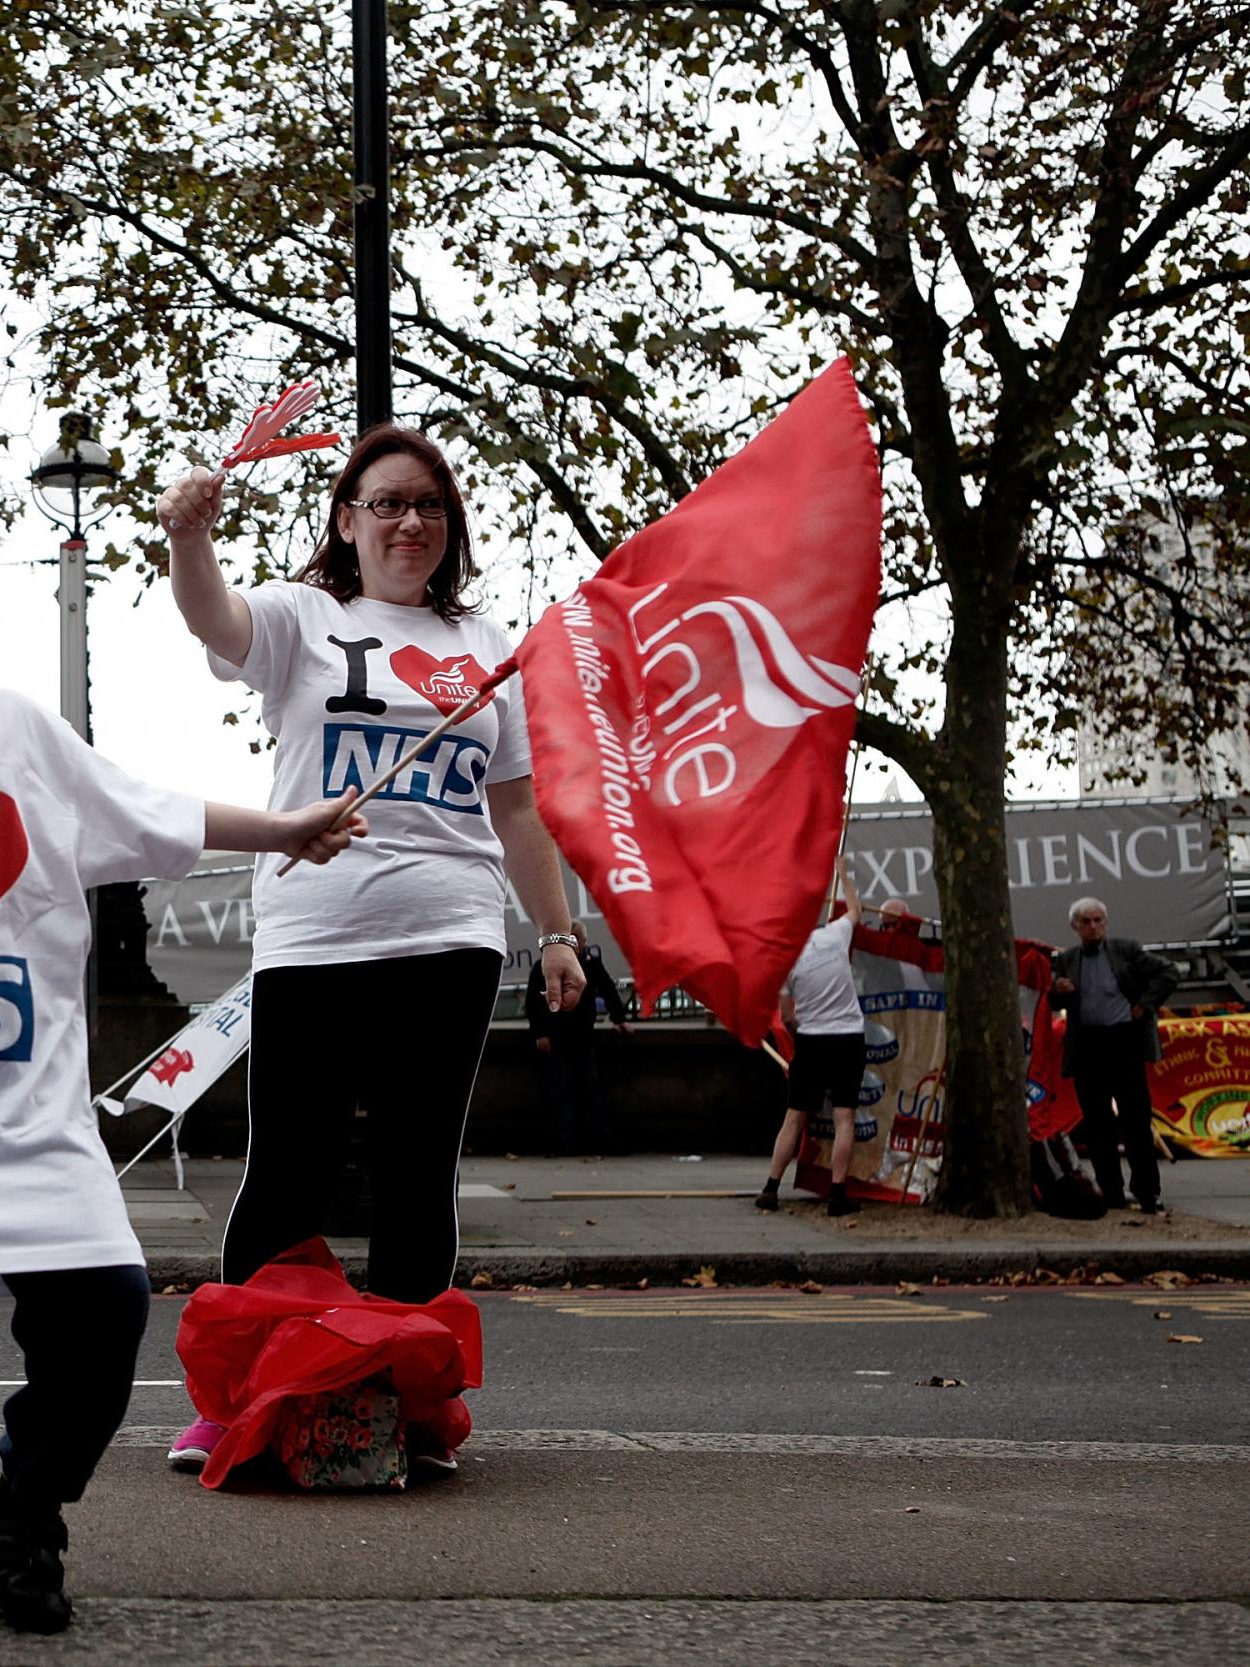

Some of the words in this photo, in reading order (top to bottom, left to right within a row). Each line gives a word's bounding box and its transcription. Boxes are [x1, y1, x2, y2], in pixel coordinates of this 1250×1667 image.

[325, 634, 387, 716] I
[628, 583, 738, 806] unite
[327, 730, 488, 807] NHS
[153, 903, 191, 947] A
